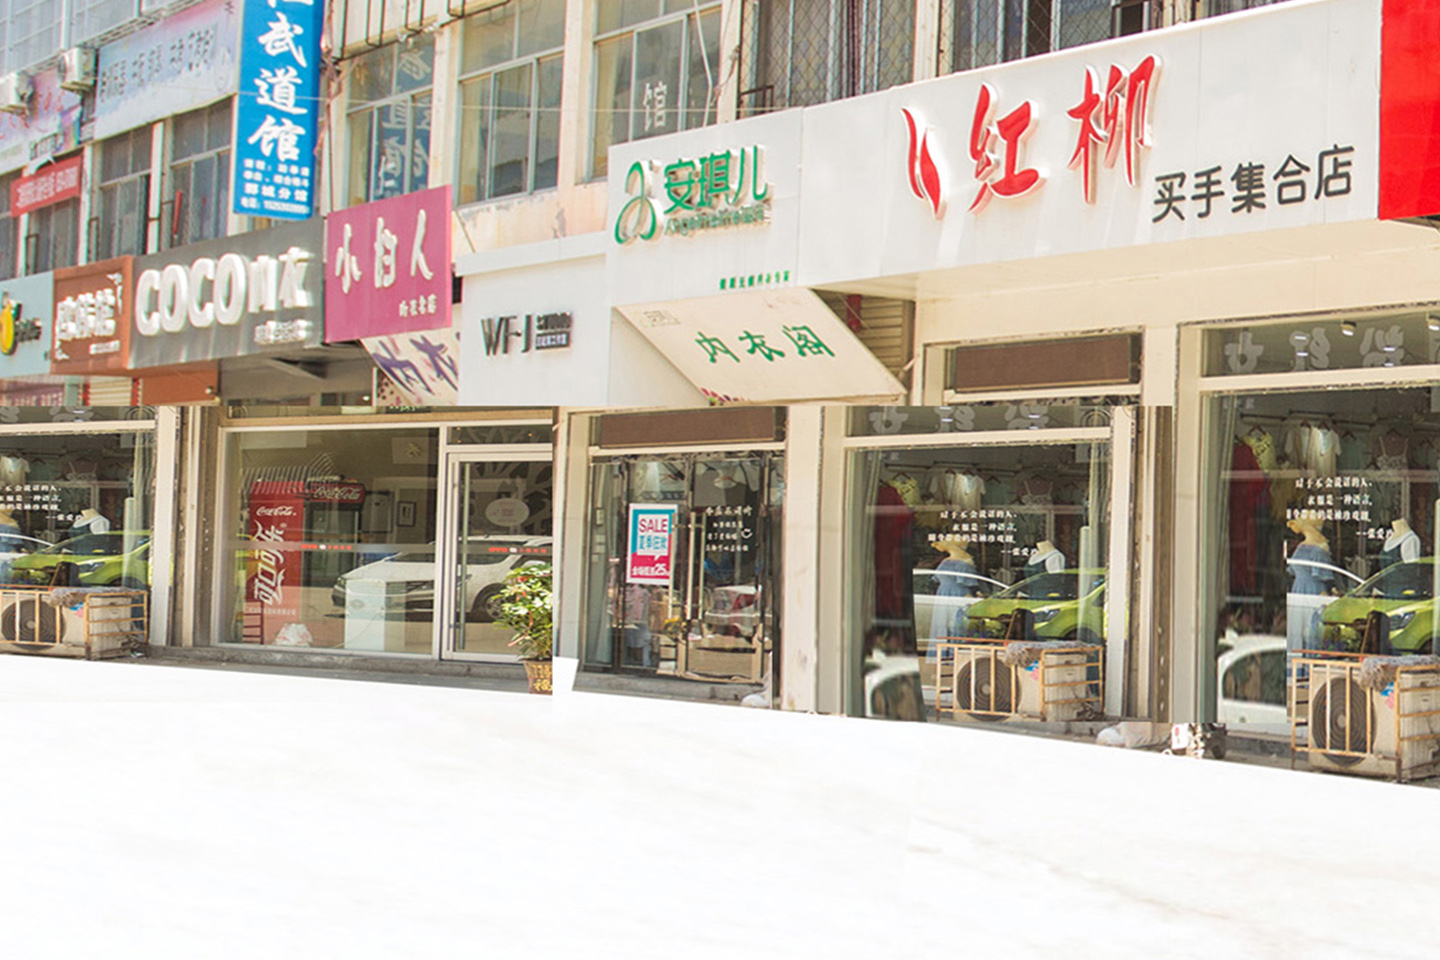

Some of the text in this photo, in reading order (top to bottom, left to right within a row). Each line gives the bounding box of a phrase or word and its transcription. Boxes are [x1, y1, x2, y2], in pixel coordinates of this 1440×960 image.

[663, 144, 768, 215] 安琪儿
[1151, 143, 1355, 224] 买手集合店
[695, 324, 836, 363] 内衣阁
[638, 518, 669, 533] SALE
